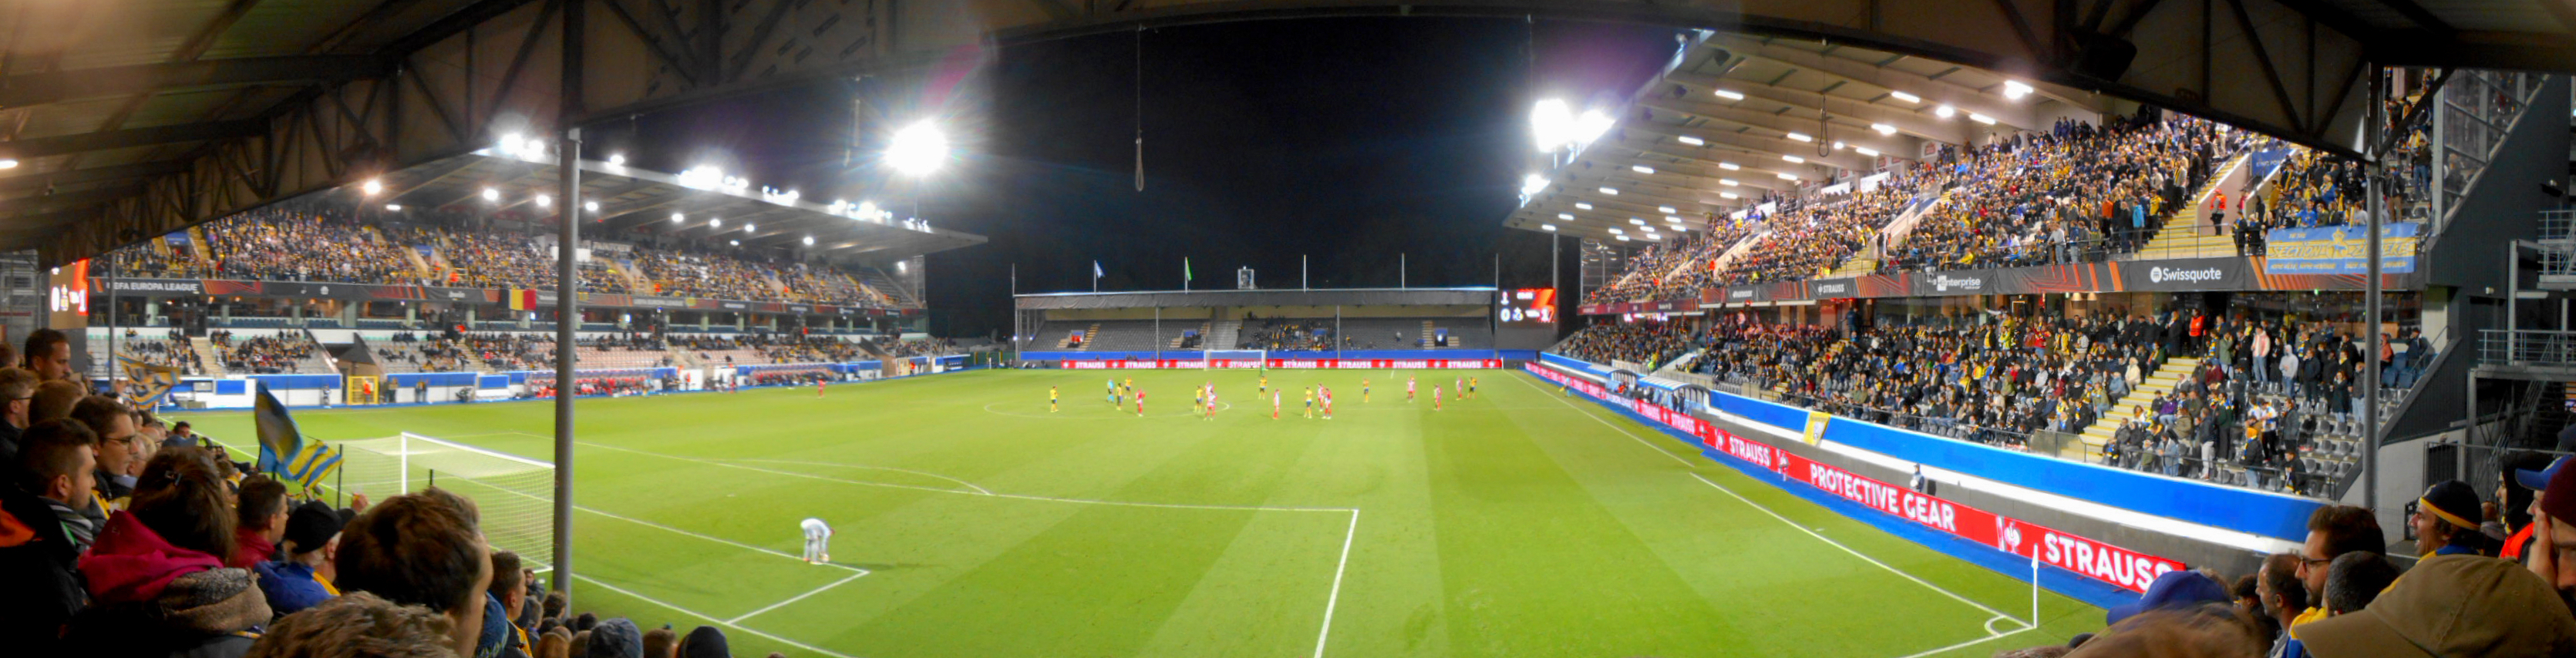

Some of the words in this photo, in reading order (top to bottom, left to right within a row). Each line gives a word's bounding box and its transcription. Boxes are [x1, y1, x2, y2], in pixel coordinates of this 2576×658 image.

[2162, 267, 2222, 284] Swissquote
[130, 282, 164, 290] EUROPA
[165, 283, 199, 291] LEAGUE
[1823, 284, 1844, 294] STRAUSS
[51, 287, 60, 312] 0
[79, 289, 86, 312] 1
[1500, 308, 1510, 321] 0
[1541, 307, 1549, 321] 1
[1729, 435, 1771, 467] STRAUSS
[1810, 462, 1900, 515] PROTECTIVE
[1903, 492, 1957, 532] GEAR
